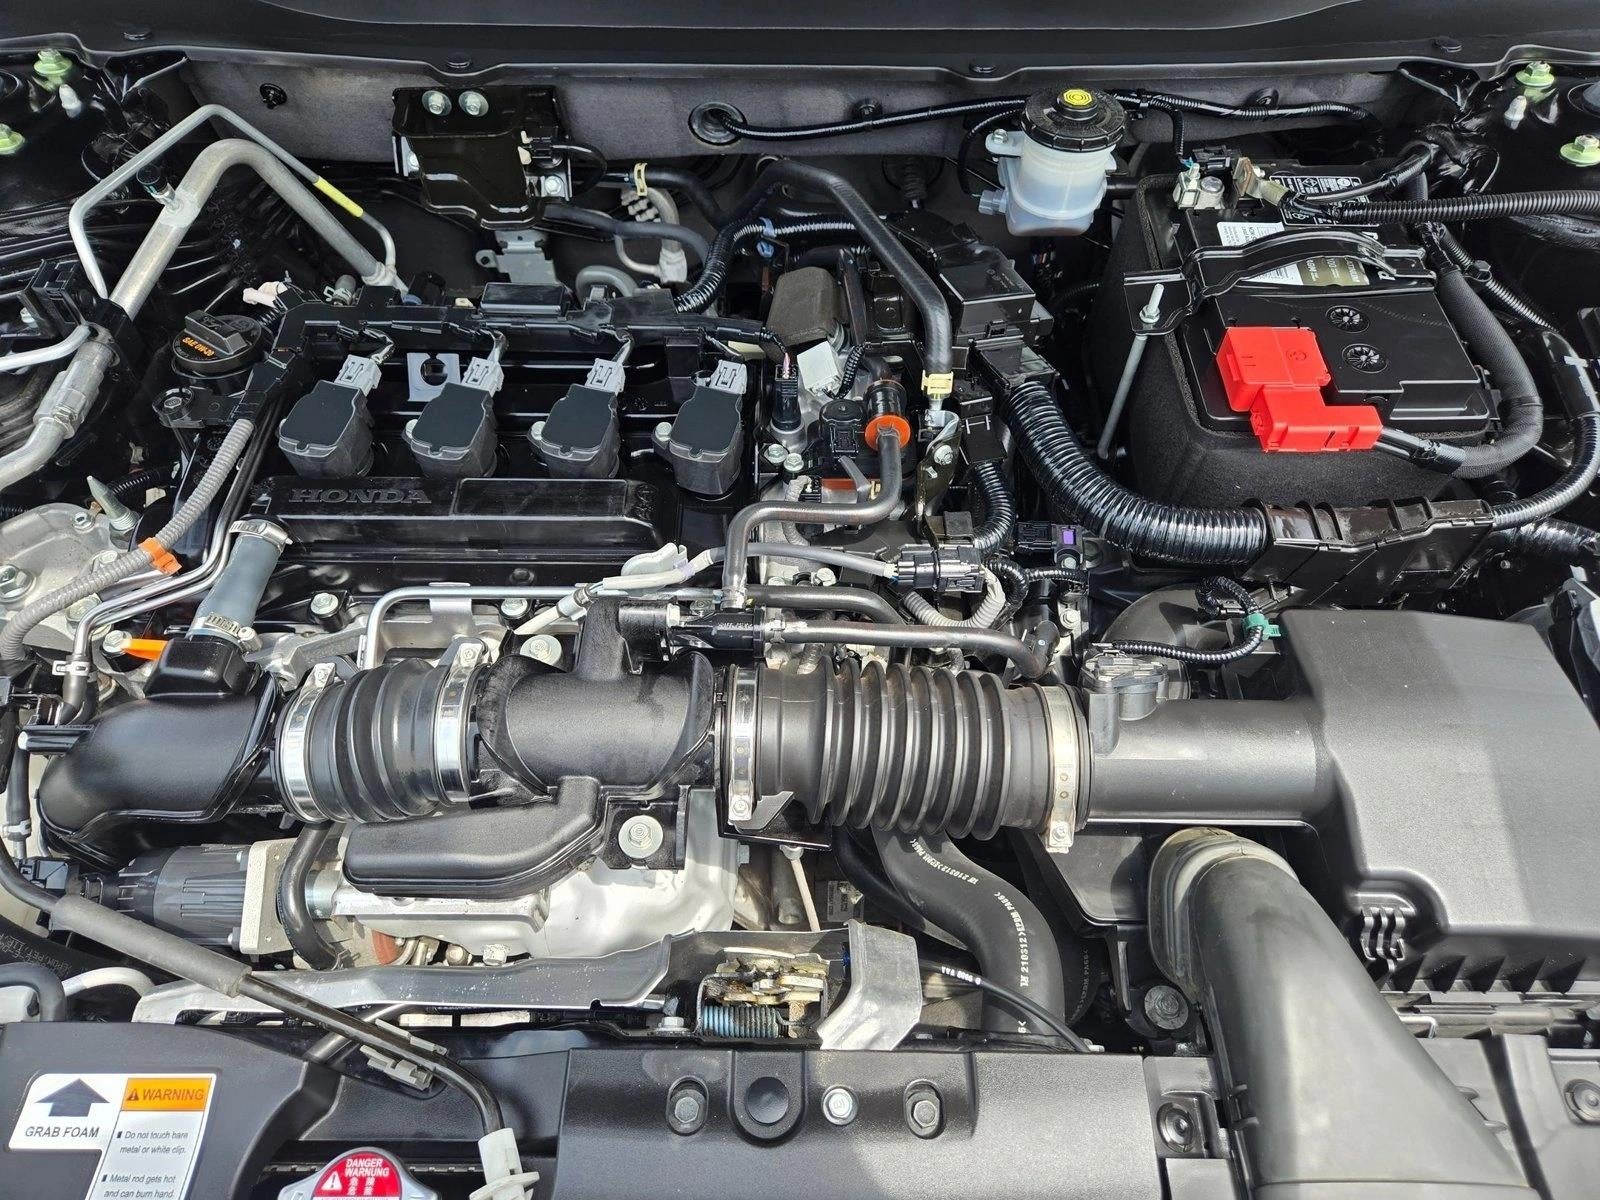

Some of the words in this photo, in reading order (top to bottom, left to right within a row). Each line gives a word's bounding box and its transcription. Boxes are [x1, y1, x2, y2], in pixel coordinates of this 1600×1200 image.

[182, 337, 198, 347] SAE
[288, 488, 432, 504] HONDA
[143, 1089, 205, 1100] WARNING
[25, 1126, 60, 1138] GRAB
[62, 1126, 100, 1138] FOAM
[124, 1131, 136, 1139] Do
[136, 1131, 150, 1139] not
[150, 1131, 171, 1139] touch
[171, 1131, 189, 1139] bare
[120, 1145, 141, 1154] metal
[151, 1145, 171, 1154] white
[345, 1158, 384, 1168] DANGER
[344, 1167, 390, 1177] WARNUNG
[109, 1174, 131, 1183] Metal
[132, 1174, 146, 1183] rod
[145, 1175, 163, 1185] gets
[163, 1174, 176, 1183] hot
[104, 1189, 120, 1198] and
[135, 1189, 153, 1198] burn
